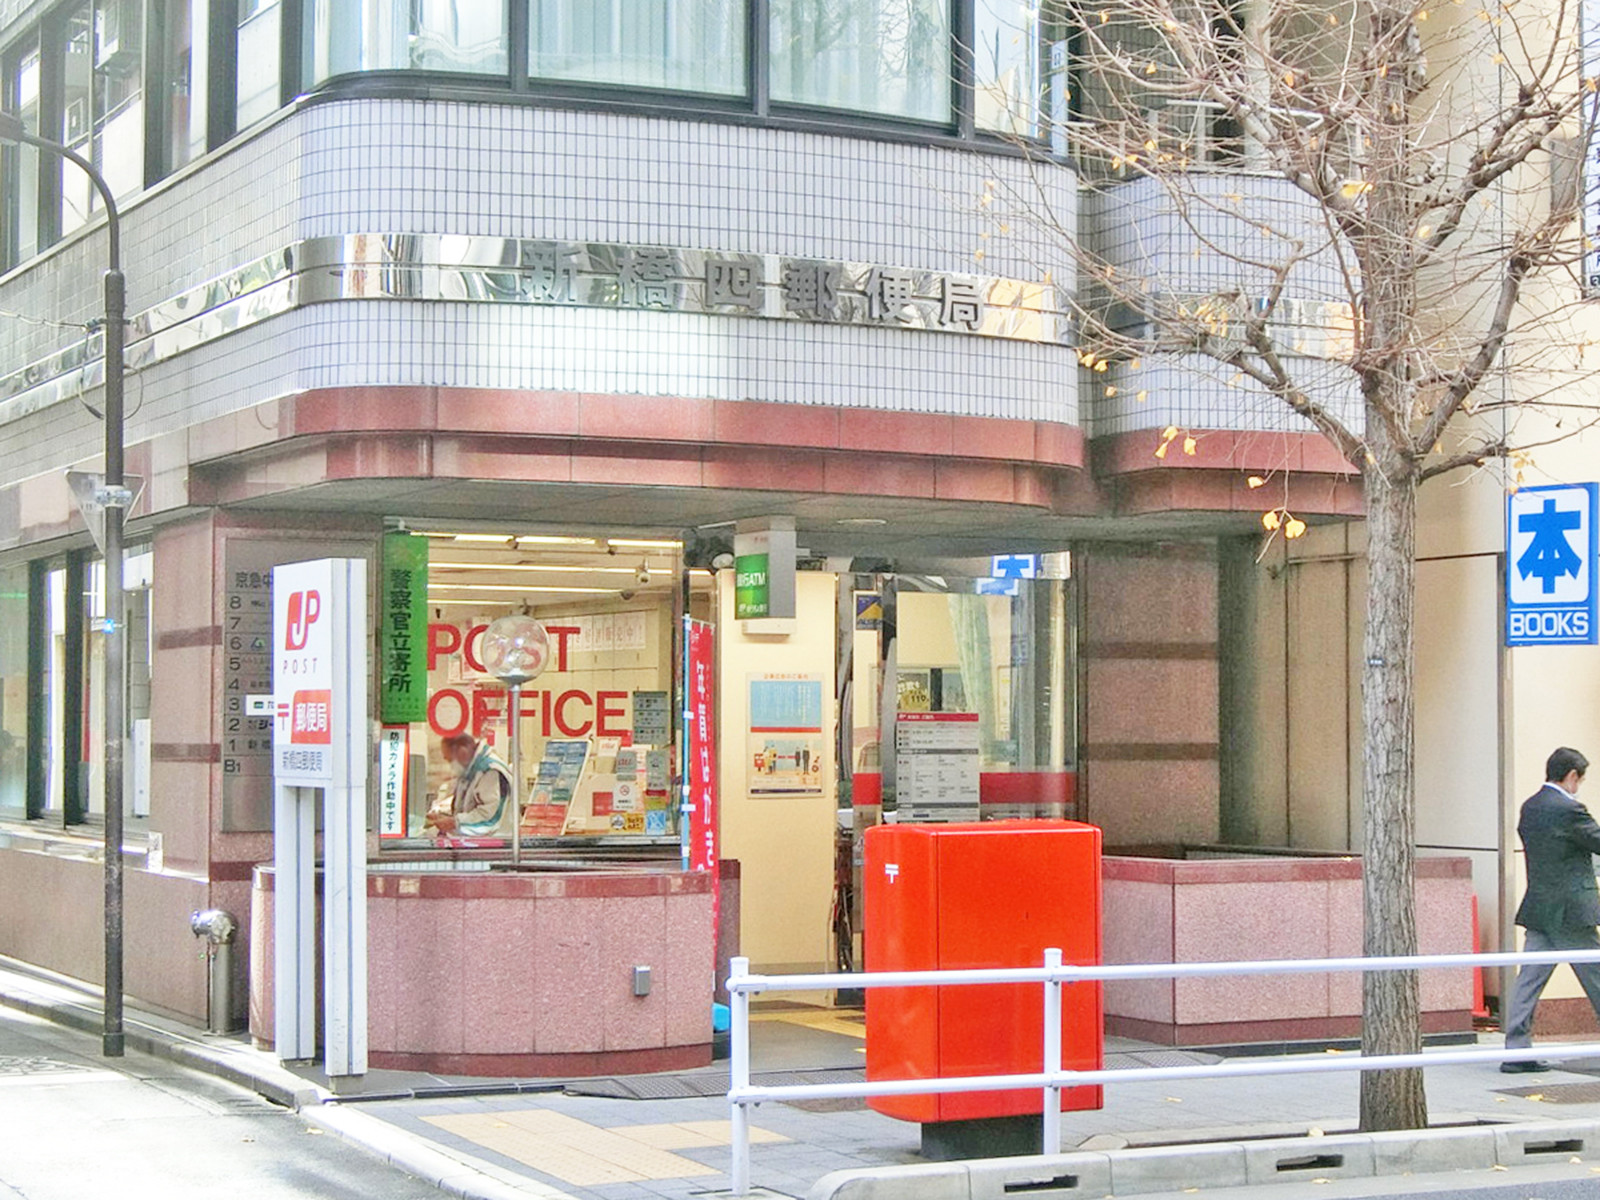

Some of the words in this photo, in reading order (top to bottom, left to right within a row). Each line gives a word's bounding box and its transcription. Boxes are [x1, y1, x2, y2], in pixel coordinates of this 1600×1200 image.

[522, 248, 984, 329] 新橋四郵便局
[1516, 499, 1582, 594] 本
[229, 595, 242, 609] 8
[229, 616, 241, 630] 7
[285, 589, 321, 651] JP
[1510, 611, 1589, 637] BOOKS
[389, 569, 412, 694] 警察官立寄所
[230, 636, 242, 651] 6
[427, 623, 581, 673] POST
[229, 657, 241, 671] 5
[282, 657, 318, 675] POST
[228, 678, 239, 690] 4
[229, 697, 240, 711] 3
[296, 702, 328, 733] 郵便局
[427, 688, 629, 738] OFFICE
[229, 718, 241, 732] 2
[228, 739, 236, 752] 1
[224, 759, 241, 772] B1
